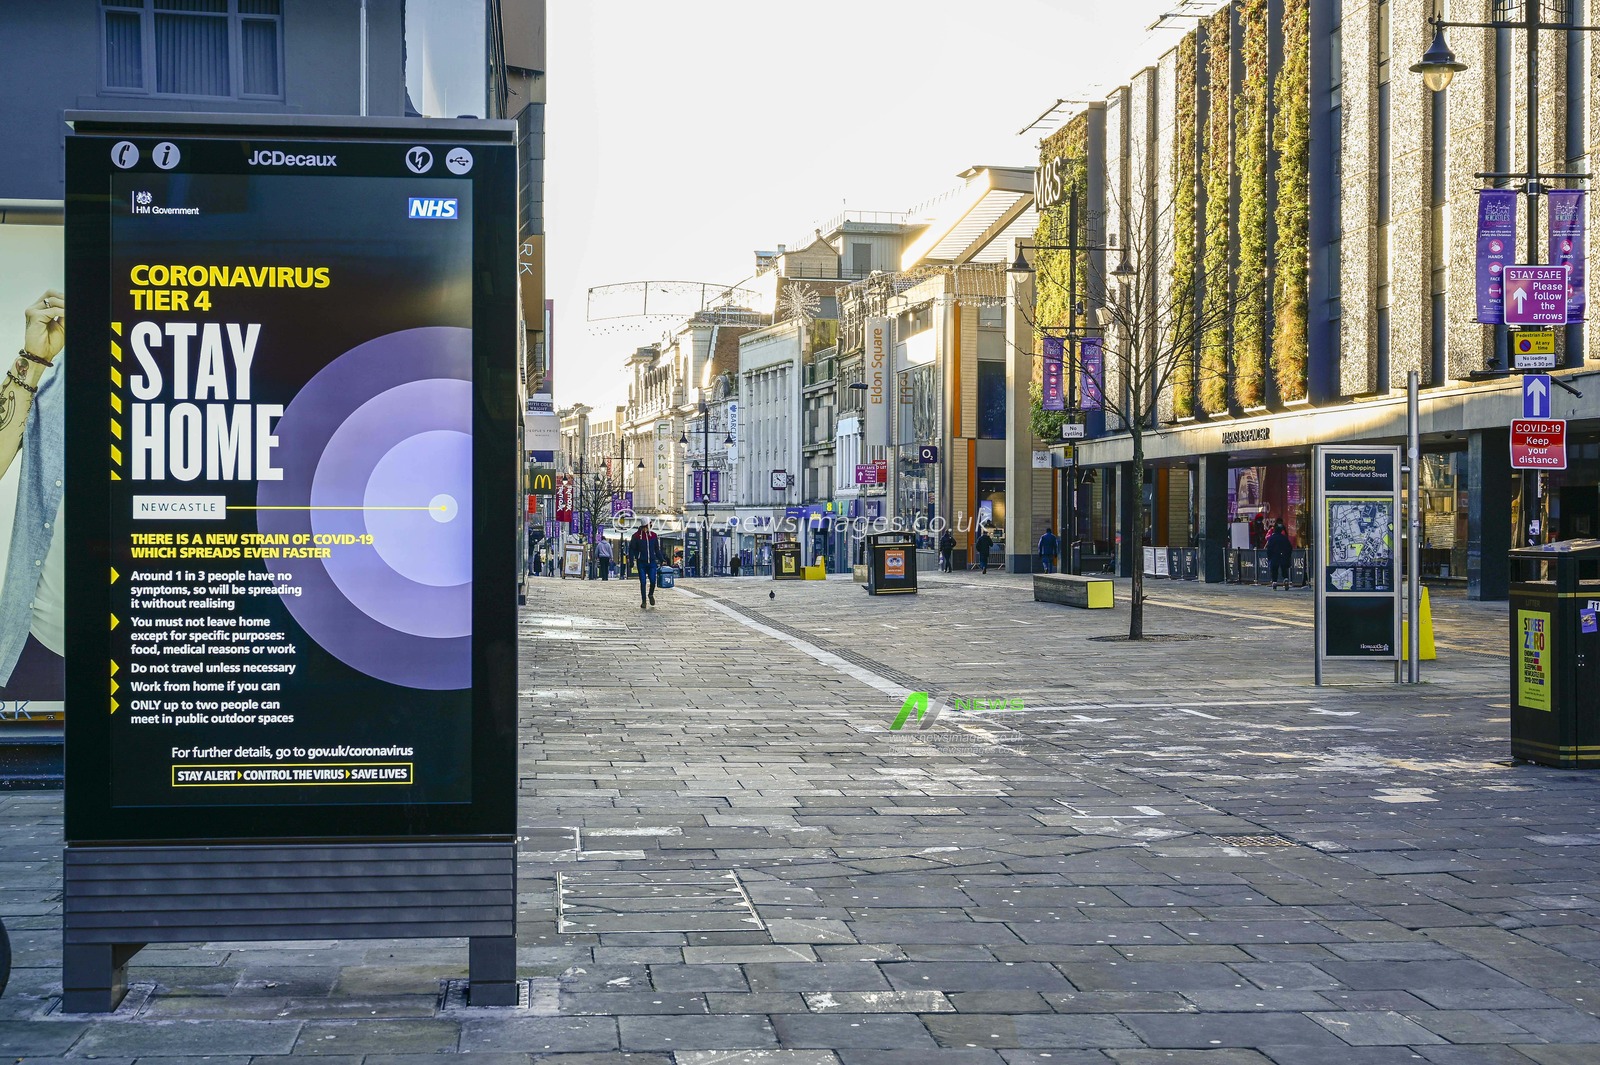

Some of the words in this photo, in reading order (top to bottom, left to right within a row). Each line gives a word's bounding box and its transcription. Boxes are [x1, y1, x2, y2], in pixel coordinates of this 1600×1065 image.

[248, 150, 337, 167] JCDecaux
[1033, 156, 1061, 212] M&S
[136, 205, 151, 214] HM
[152, 205, 200, 216] Government
[411, 199, 456, 218] NHS
[130, 264, 331, 289] CORONAVIRUS
[1510, 270, 1535, 279] STAY
[1537, 270, 1562, 279] SAFE
[1533, 282, 1563, 291] Please
[130, 289, 190, 312] TIER
[194, 290, 212, 312] 4
[1534, 291, 1562, 300] follow
[1541, 302, 1555, 310] the
[871, 328, 885, 368] Square
[130, 321, 262, 401] STAY
[870, 372, 883, 404] Eldon
[1515, 423, 1561, 433] COVID-19
[131, 402, 284, 482] HOME
[1526, 436, 1549, 446] Keep
[1519, 456, 1559, 465] distance
[1349, 464, 1376, 472] Shopping
[141, 502, 217, 513] NEWCASTLE
[130, 534, 172, 544] THERE
[176, 534, 188, 544] IS
[191, 534, 203, 544] A
[205, 534, 238, 544] NEW
[240, 534, 288, 544] STRAIN
[292, 534, 310, 544] OF
[313, 534, 374, 544] COVID-19
[130, 548, 176, 558] WHICH
[179, 548, 240, 558] SPREADS
[243, 548, 279, 558] EVEN
[282, 548, 330, 558] FASTER
[130, 571, 172, 581] Around
[175, 571, 181, 581] 1
[184, 571, 195, 581] in
[197, 571, 205, 581] 3
[207, 571, 245, 583] people
[247, 571, 275, 581] have
[277, 573, 292, 581] no
[130, 586, 190, 597] symptoms,
[192, 586, 206, 594] so
[208, 584, 229, 594] will
[231, 584, 246, 594] be
[247, 584, 302, 597] spreading
[130, 598, 139, 608] it
[141, 598, 186, 608] without
[188, 598, 235, 610] realising
[130, 617, 152, 627] You
[154, 618, 183, 627] must
[185, 618, 204, 627] not
[206, 617, 236, 626] leave
[238, 616, 270, 626] home
[1523, 617, 1545, 632] STREET
[130, 631, 168, 642] except
[169, 630, 187, 641] for
[188, 630, 230, 643] specific
[231, 632, 285, 642] purposes:
[1523, 631, 1545, 651] ZERO
[130, 644, 160, 656] food,
[162, 644, 205, 654] medical
[207, 646, 250, 654] reasons
[251, 646, 265, 654] or
[266, 644, 296, 654] work
[130, 663, 147, 673] Do
[149, 664, 169, 673] not
[170, 662, 203, 673] travel
[205, 662, 240, 672] unless
[242, 664, 297, 675] necessary
[130, 681, 161, 692] Work
[163, 681, 190, 692] from
[192, 681, 224, 691] home
[226, 681, 235, 691] if
[237, 683, 258, 693] you
[260, 682, 280, 691] can
[130, 700, 161, 710] ONLY
[163, 702, 178, 712] up
[180, 701, 193, 710] to
[195, 701, 218, 709] two
[220, 699, 258, 712] people
[130, 714, 159, 724] meet
[161, 714, 172, 723] in
[175, 713, 208, 726] public
[210, 713, 256, 723] outdoor
[257, 714, 294, 725] spaces
[171, 747, 190, 758] For
[191, 746, 232, 758] further
[233, 746, 273, 759] details,
[275, 749, 291, 759] go
[292, 747, 305, 757] to
[307, 745, 414, 760] gov.uk/coronavirus
[177, 771, 204, 781] STAY
[204, 771, 237, 780] ALERT
[243, 770, 292, 780] CONTROL
[293, 770, 312, 780] THE
[313, 770, 345, 779] VIRUS
[351, 769, 378, 779] SAVE
[379, 769, 408, 779] LIVES
